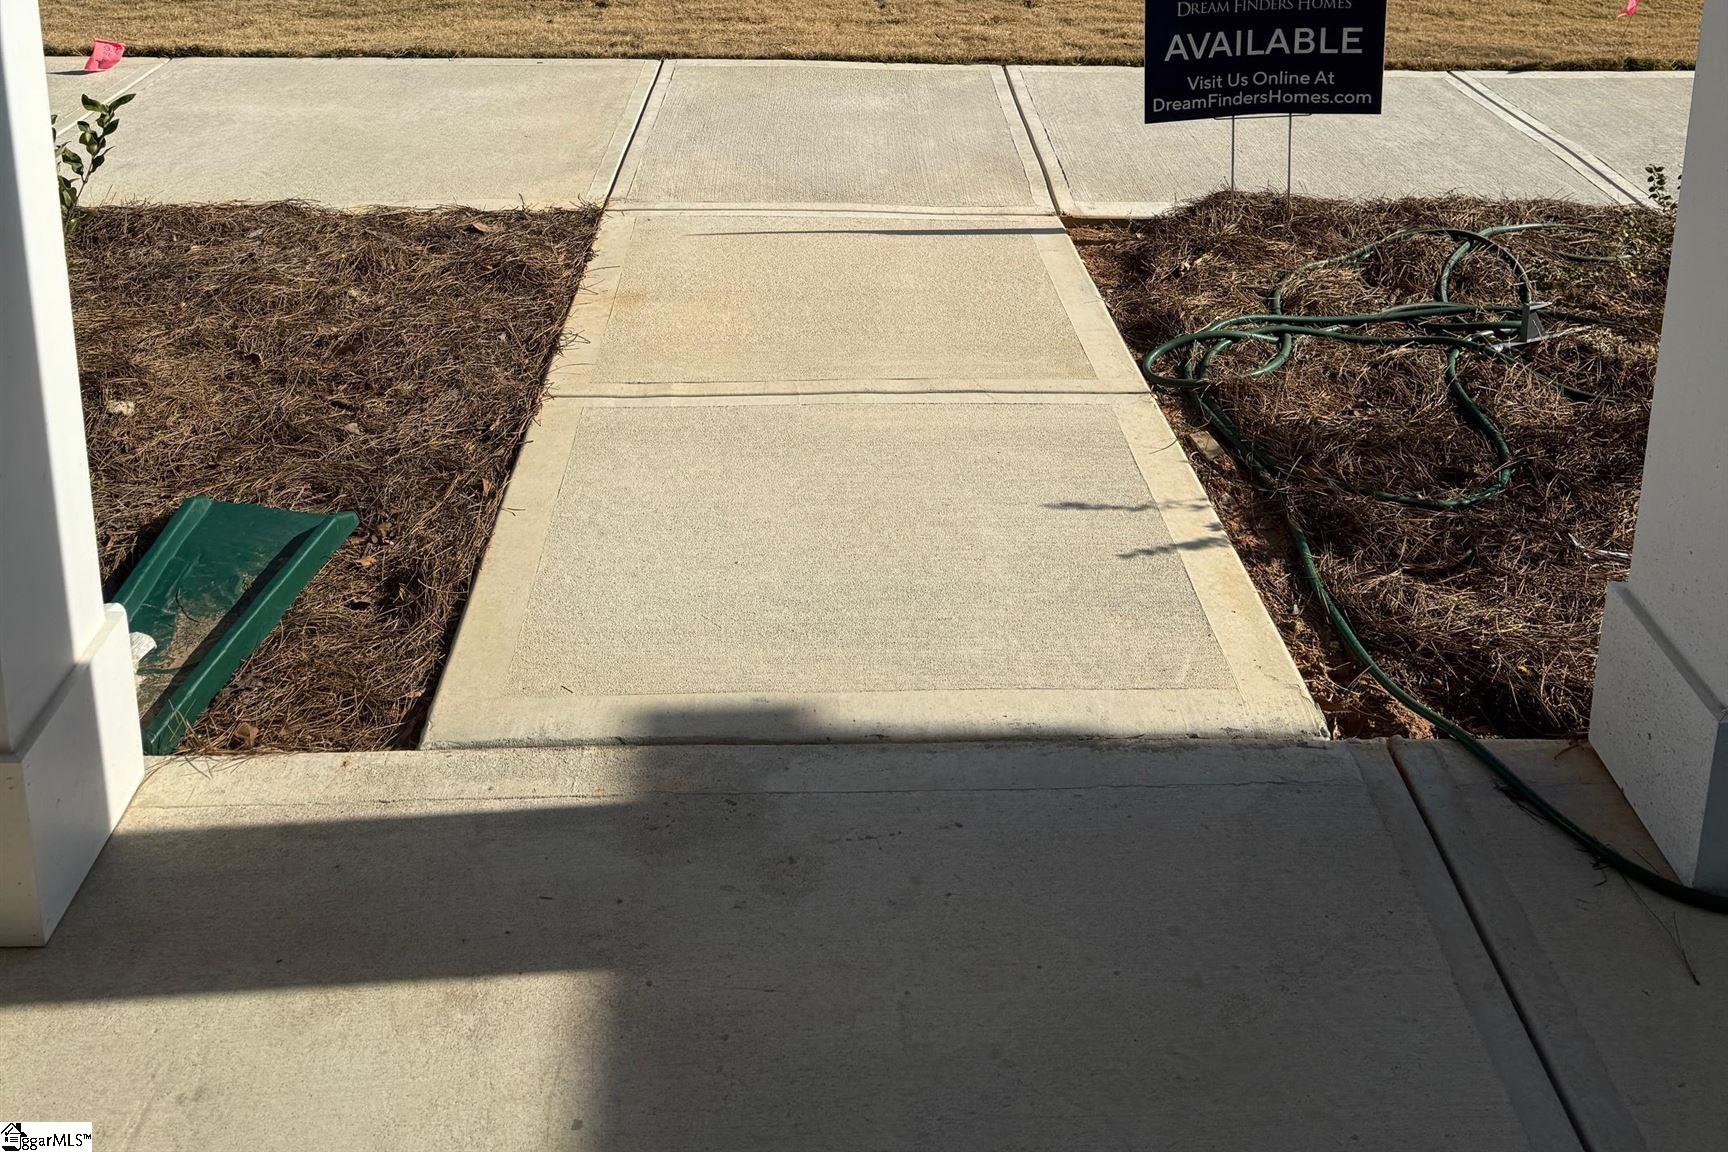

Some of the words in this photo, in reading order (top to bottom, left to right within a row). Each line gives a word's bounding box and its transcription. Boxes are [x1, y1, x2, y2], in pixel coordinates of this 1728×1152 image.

[1177, 0, 1230, 17] DREAM
[1164, 26, 1364, 62] AVAILABLE
[1187, 74, 1223, 91] Visit
[1228, 72, 1248, 88] Us
[1252, 71, 1311, 87] Online
[1314, 70, 1336, 86] At
[1152, 89, 1372, 113] DreamFindersHomes.com
